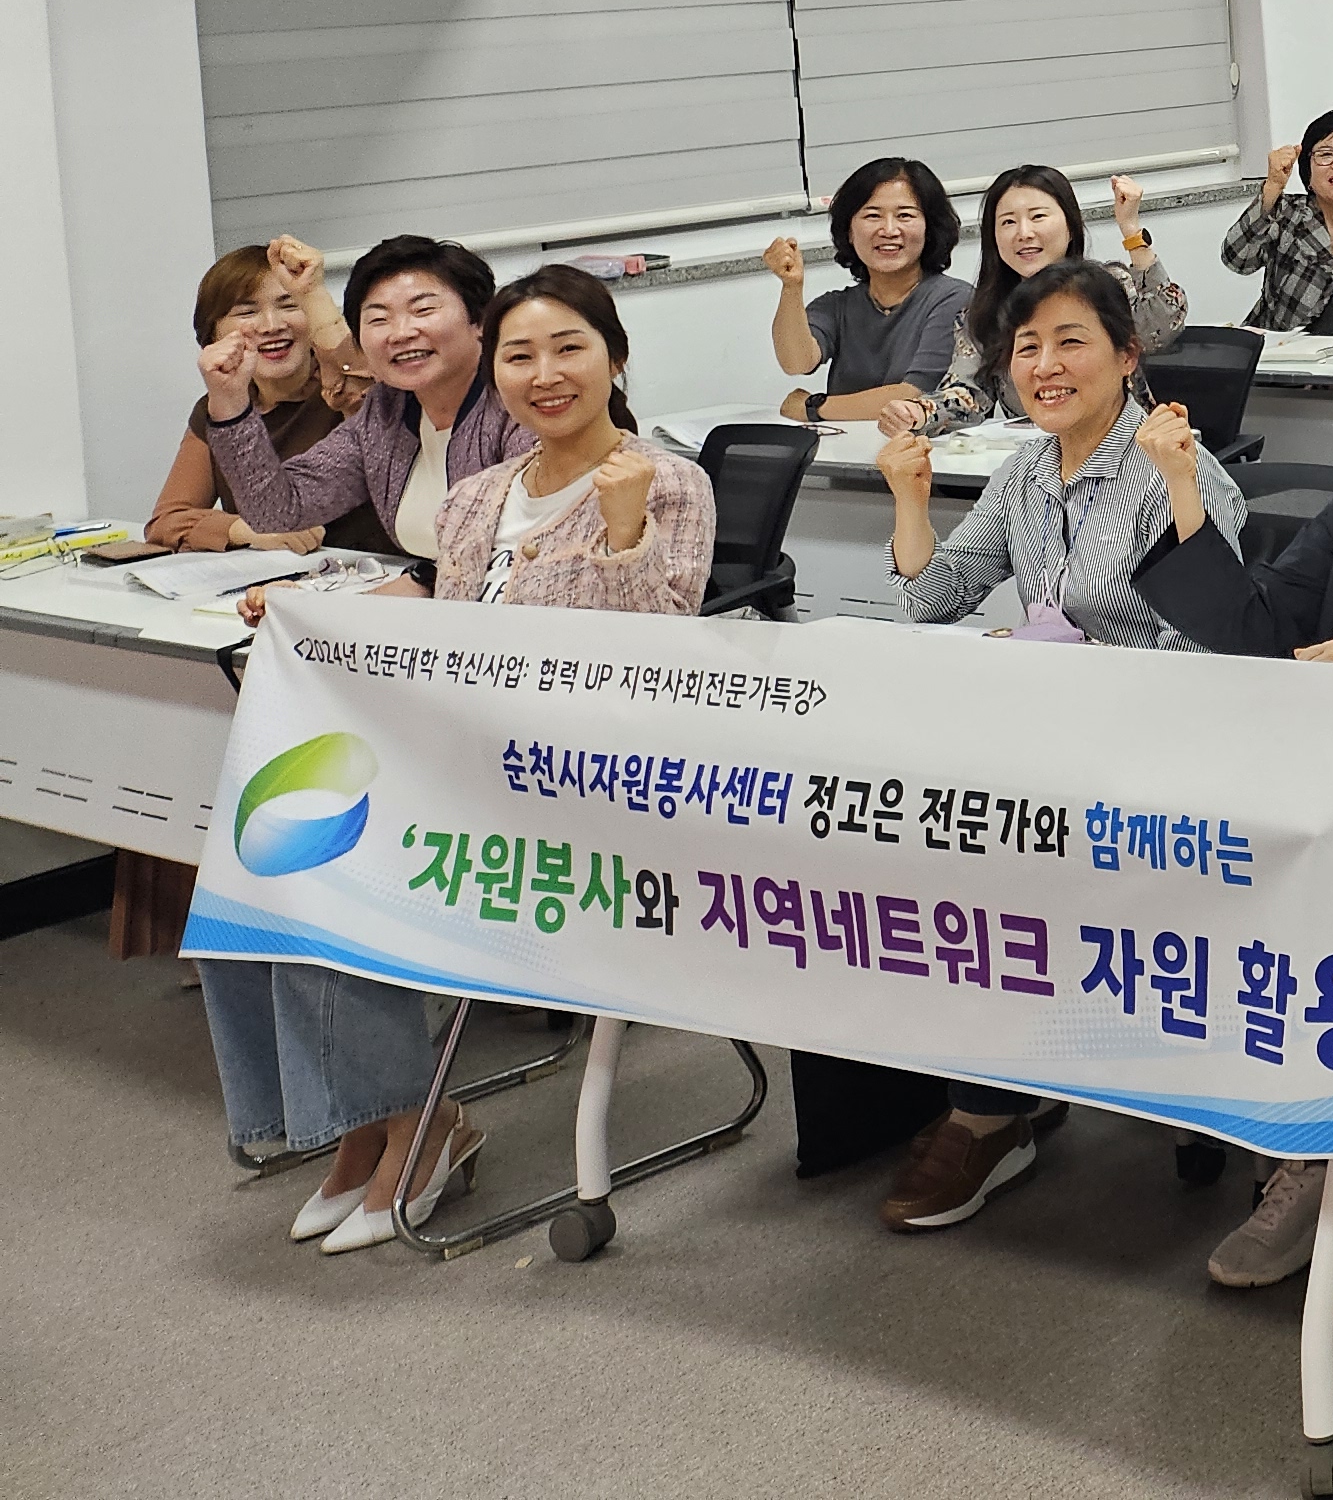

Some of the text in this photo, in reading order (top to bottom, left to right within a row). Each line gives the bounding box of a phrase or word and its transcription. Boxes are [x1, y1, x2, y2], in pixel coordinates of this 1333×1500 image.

[293, 636, 828, 716] <2024년 전문대학 혁신사업: 협력 UP 지역사회전문가특강>
[502, 739, 1254, 887] 순천시자원봉사센터 정고은 전문가와 함께하는
[697, 871, 1055, 997] 지역네트워크
[1080, 924, 1209, 1040] 자원
